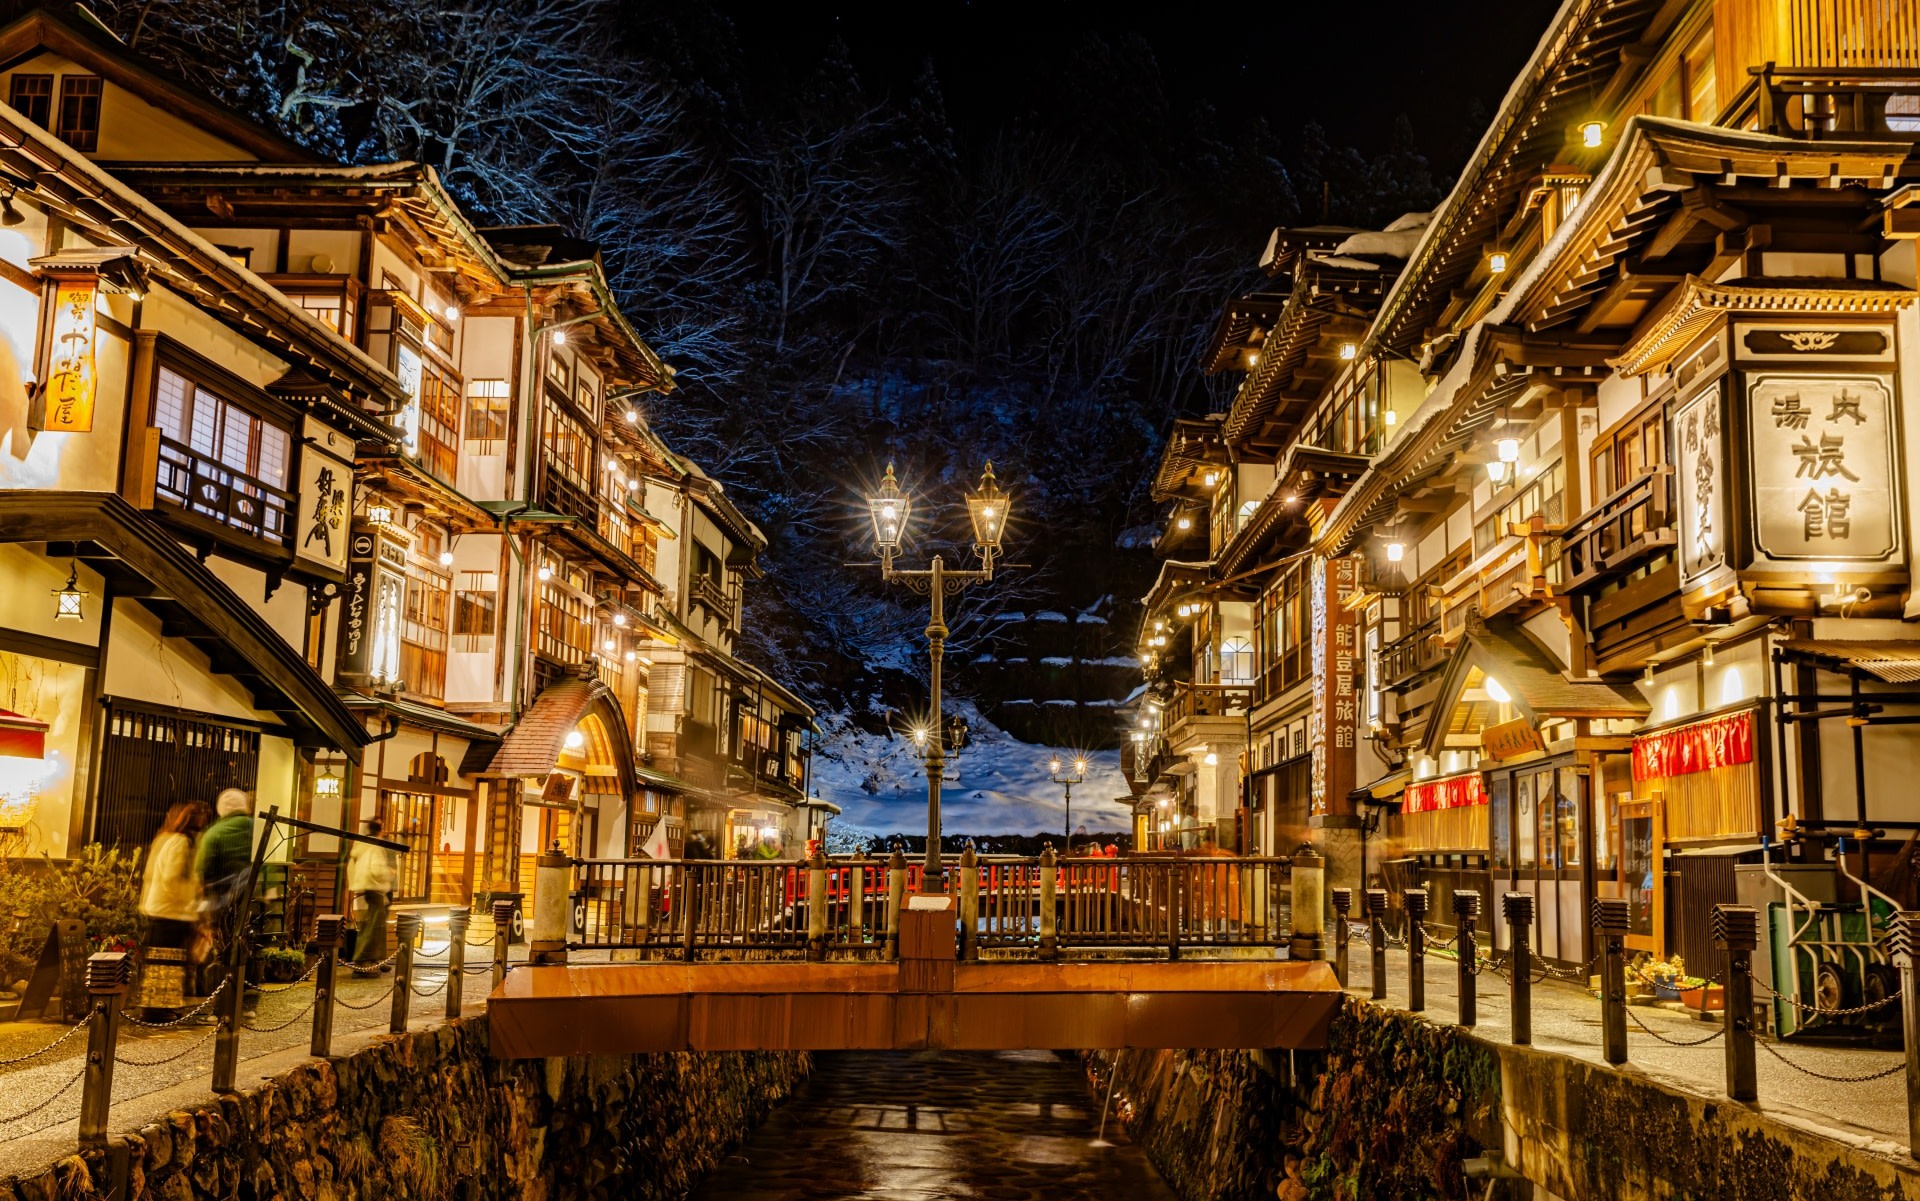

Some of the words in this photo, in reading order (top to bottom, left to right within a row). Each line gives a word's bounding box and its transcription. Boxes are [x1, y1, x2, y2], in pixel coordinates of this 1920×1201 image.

[1791, 430, 1861, 542] 旅館
[1335, 623, 1354, 749] 能登屋旅館
